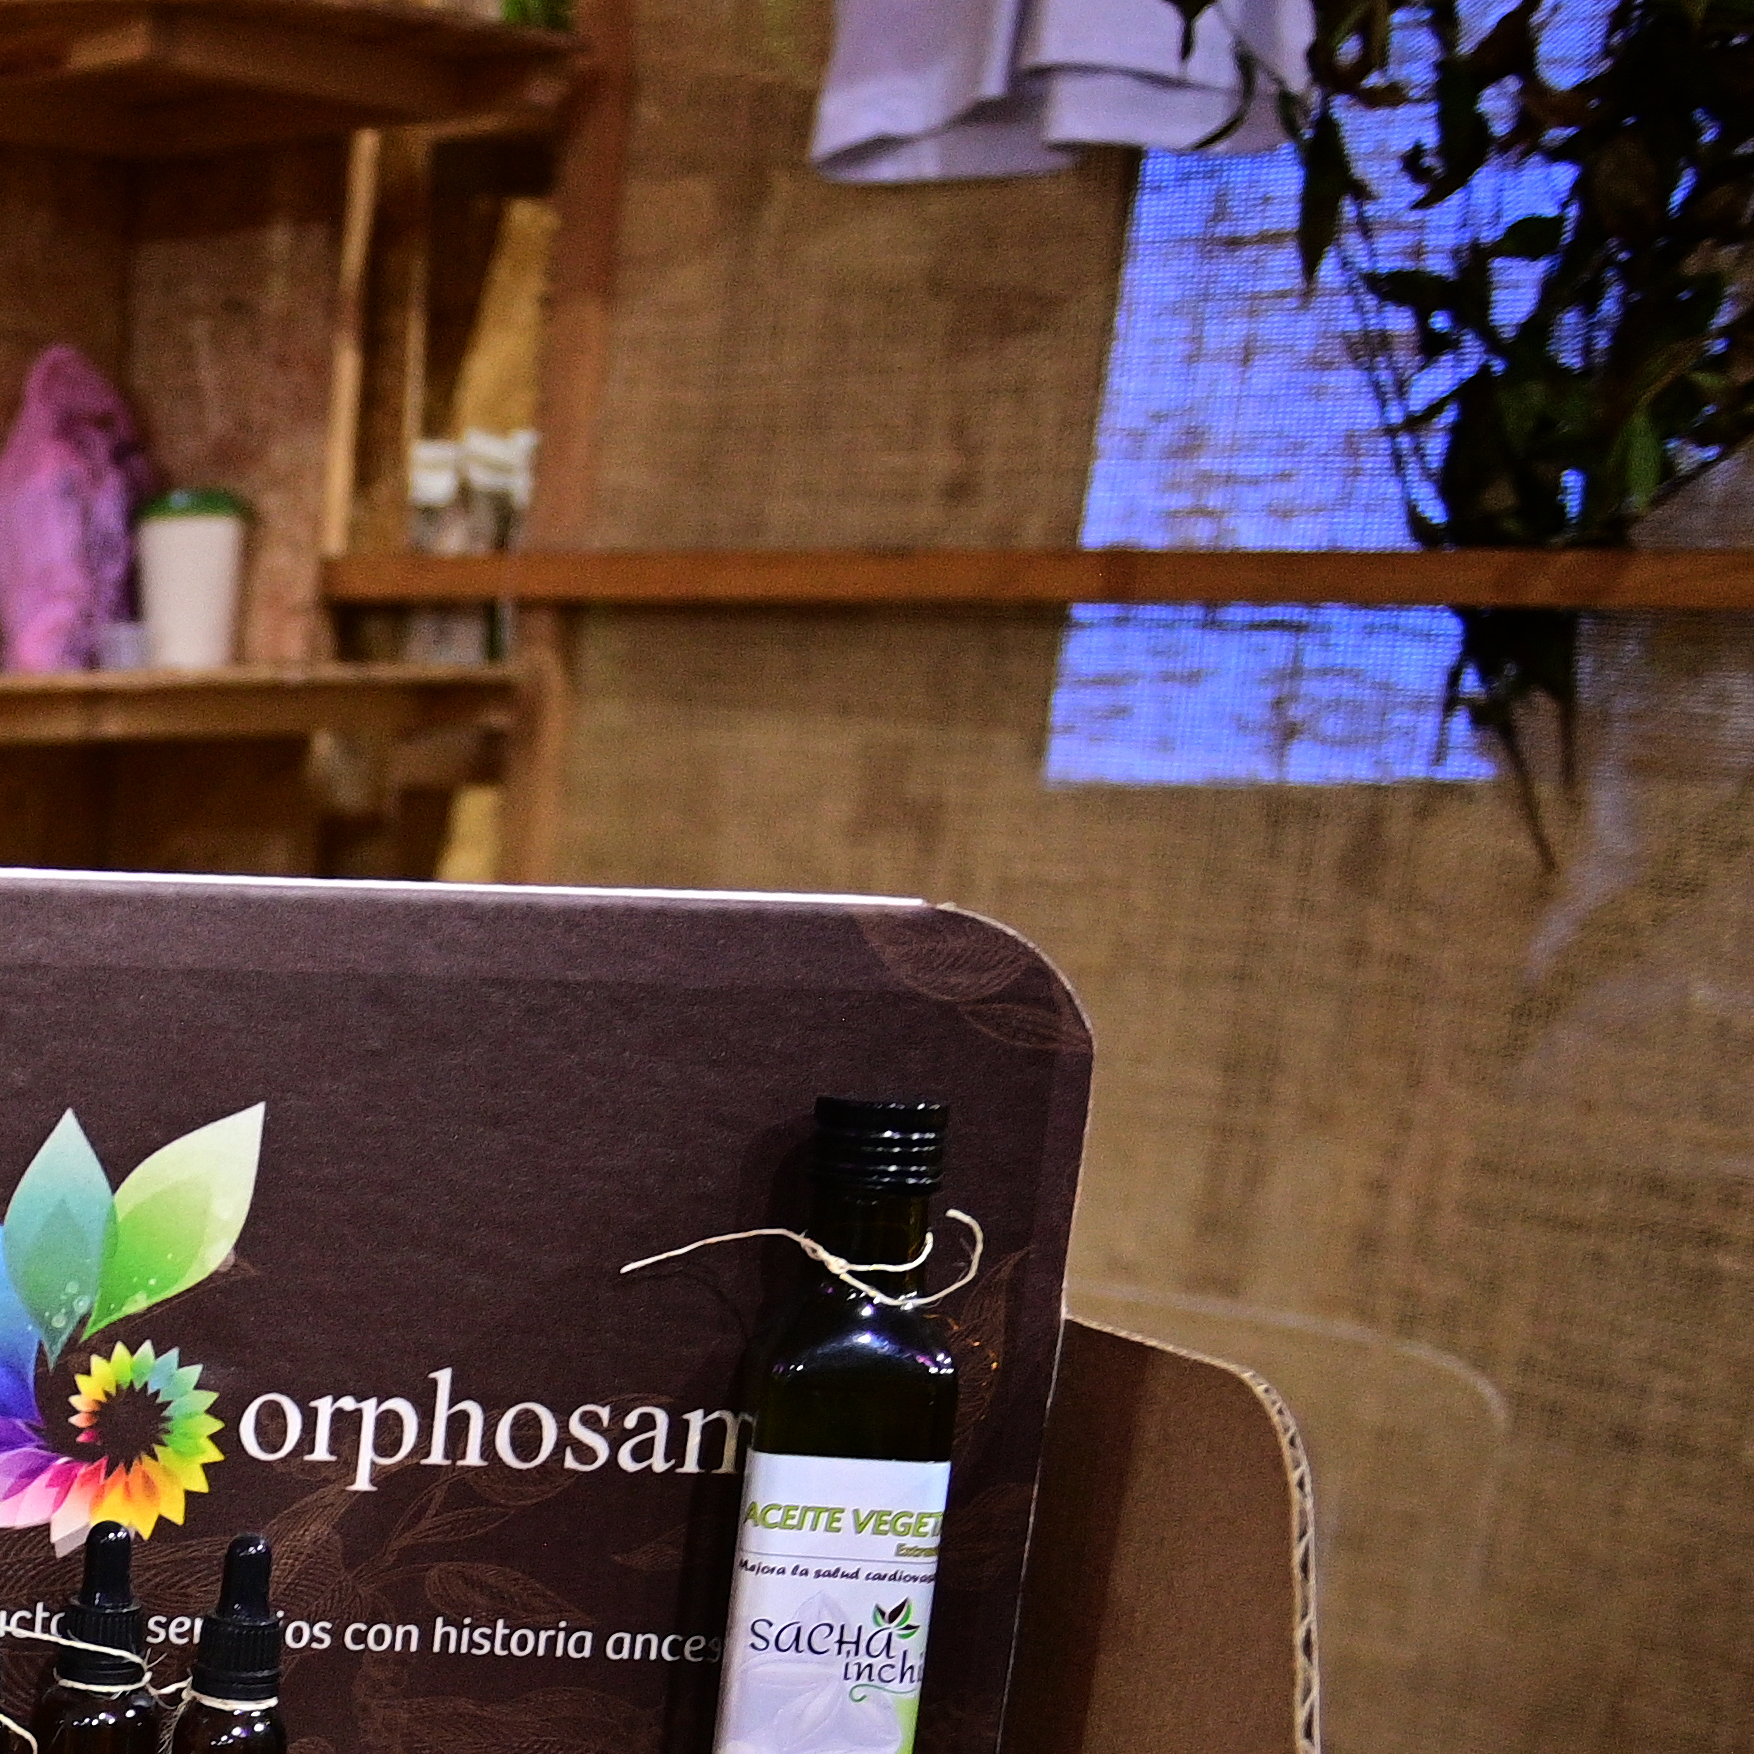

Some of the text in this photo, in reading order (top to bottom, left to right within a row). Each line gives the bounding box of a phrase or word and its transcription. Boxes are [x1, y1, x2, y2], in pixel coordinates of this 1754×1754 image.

[744, 1501, 943, 1537] ACEITE VEGET
[791, 1564, 808, 1576] la
[813, 1565, 860, 1580] salud
[344, 1622, 419, 1652] con
[433, 1616, 592, 1659] historia
